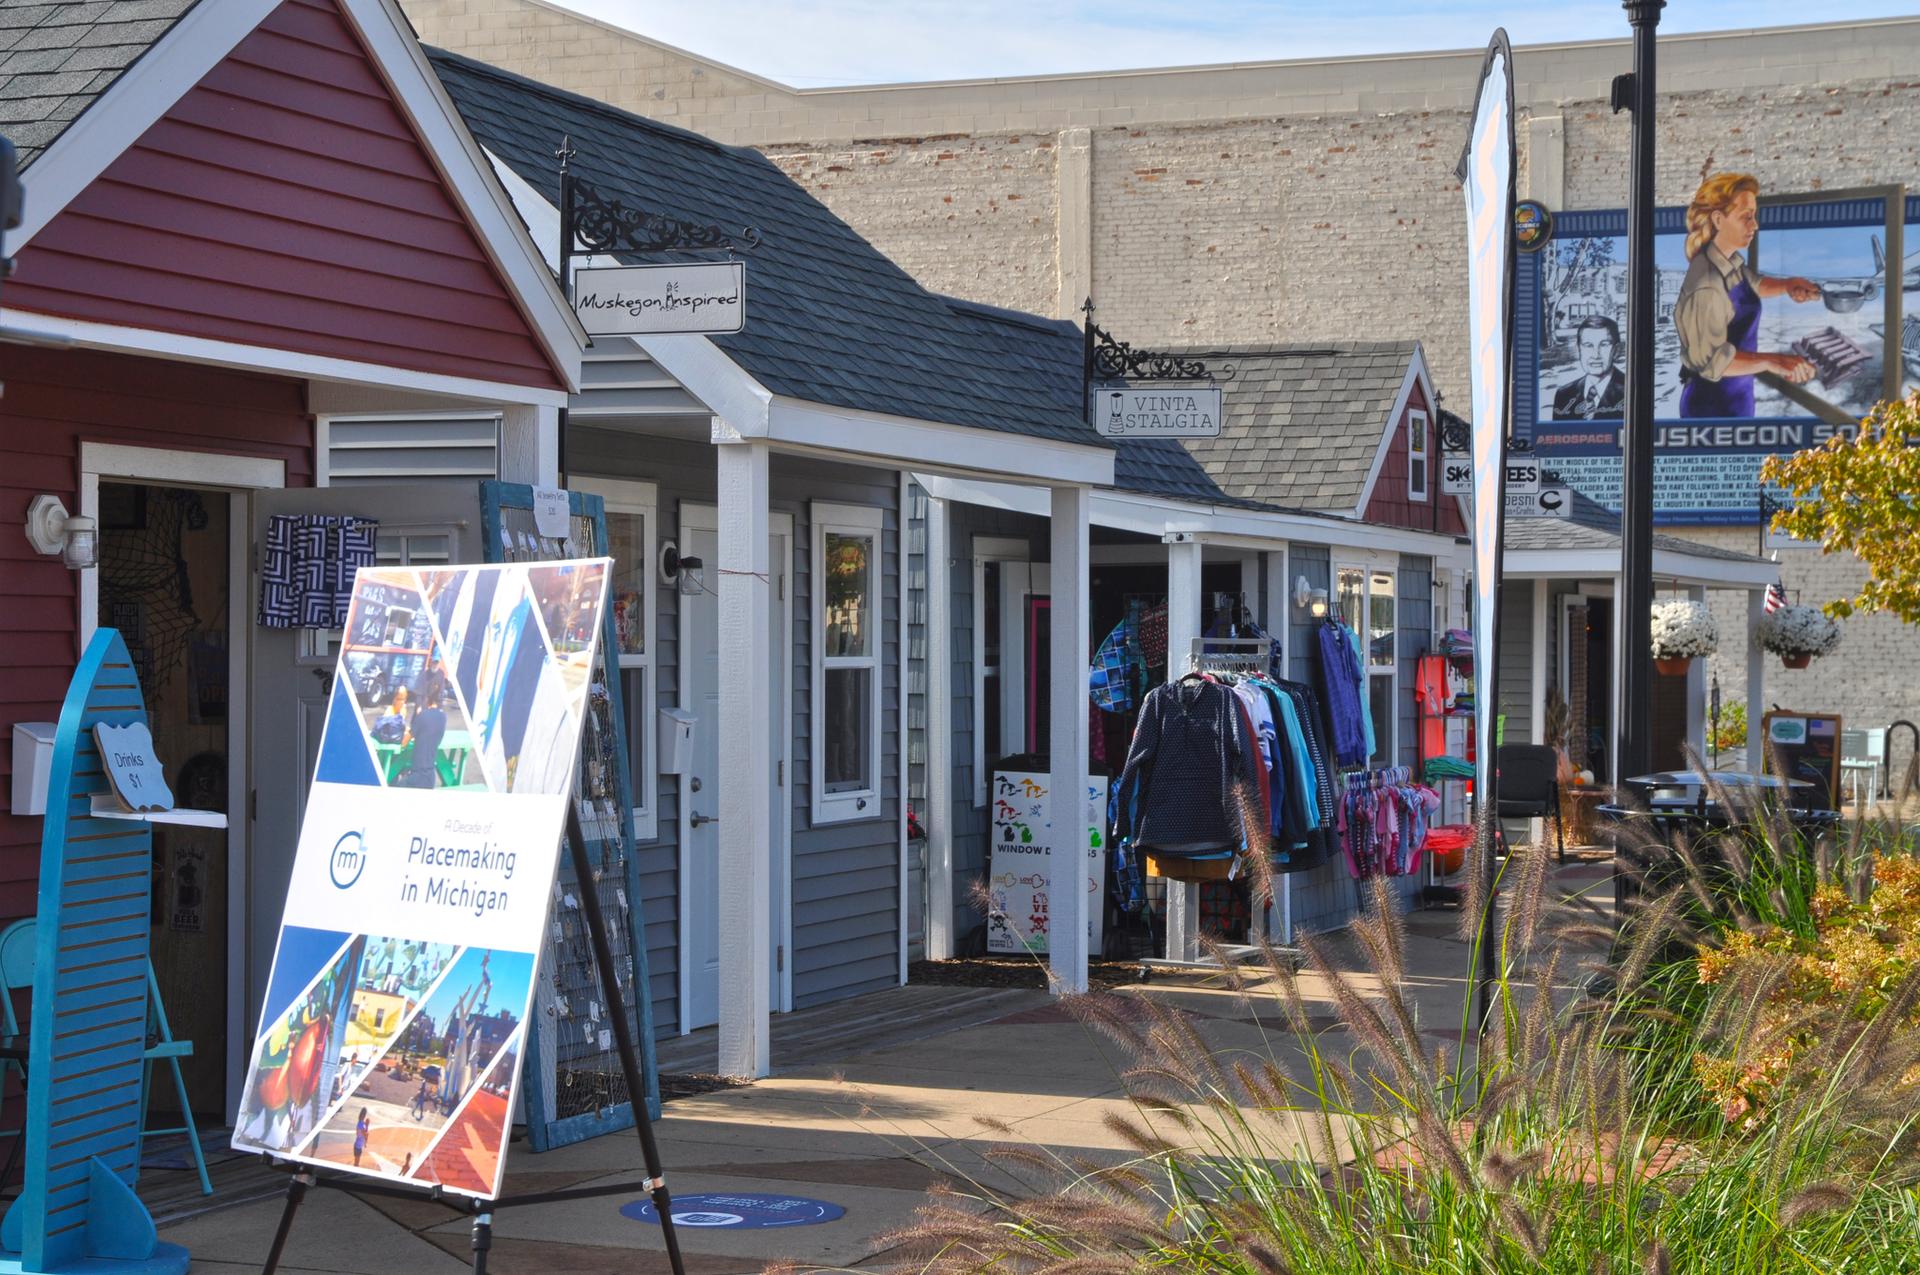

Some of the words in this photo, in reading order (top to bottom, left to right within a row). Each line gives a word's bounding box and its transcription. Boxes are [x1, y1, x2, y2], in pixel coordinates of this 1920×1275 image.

[579, 292, 662, 316] Muskegon
[1134, 397, 1198, 411] VINTA
[1125, 413, 1213, 428] STALGIA
[1536, 434, 1613, 445] AEROSPACE
[1617, 425, 1803, 448] USKEGON
[1566, 458, 1589, 466] MIDDLE
[1663, 457, 1699, 465] AIRPLANES
[1720, 456, 1745, 464] SECOND
[1691, 465, 1718, 473] ARRIVAL
[1706, 499, 1741, 508] MUSKEGON
[114, 752, 144, 768] Drinks
[129, 772, 143, 789] $1
[997, 844, 1043, 855] WINDOW
[408, 837, 516, 880] Placemaking
[401, 875, 418, 902] in
[425, 877, 509, 917] Michigan
